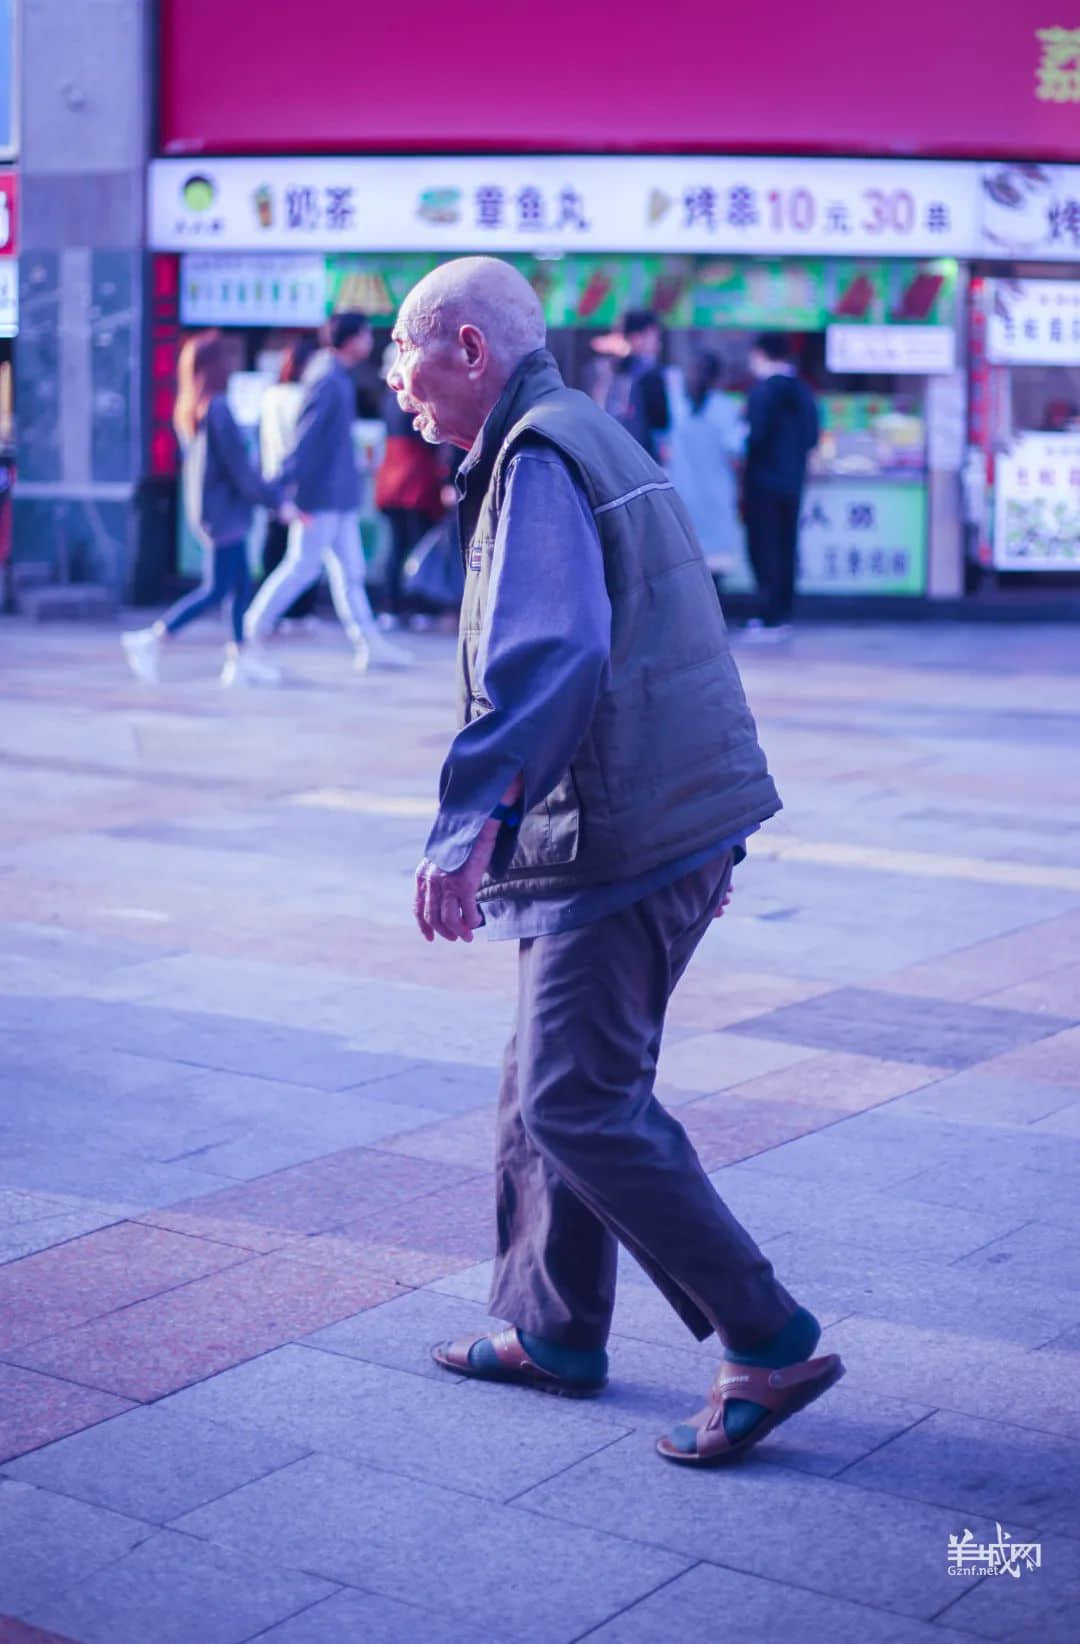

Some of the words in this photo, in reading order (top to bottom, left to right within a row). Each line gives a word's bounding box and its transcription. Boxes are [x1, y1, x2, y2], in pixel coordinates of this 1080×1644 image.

[286, 185, 355, 231] 奶茶
[475, 184, 588, 232] 章鱼丸
